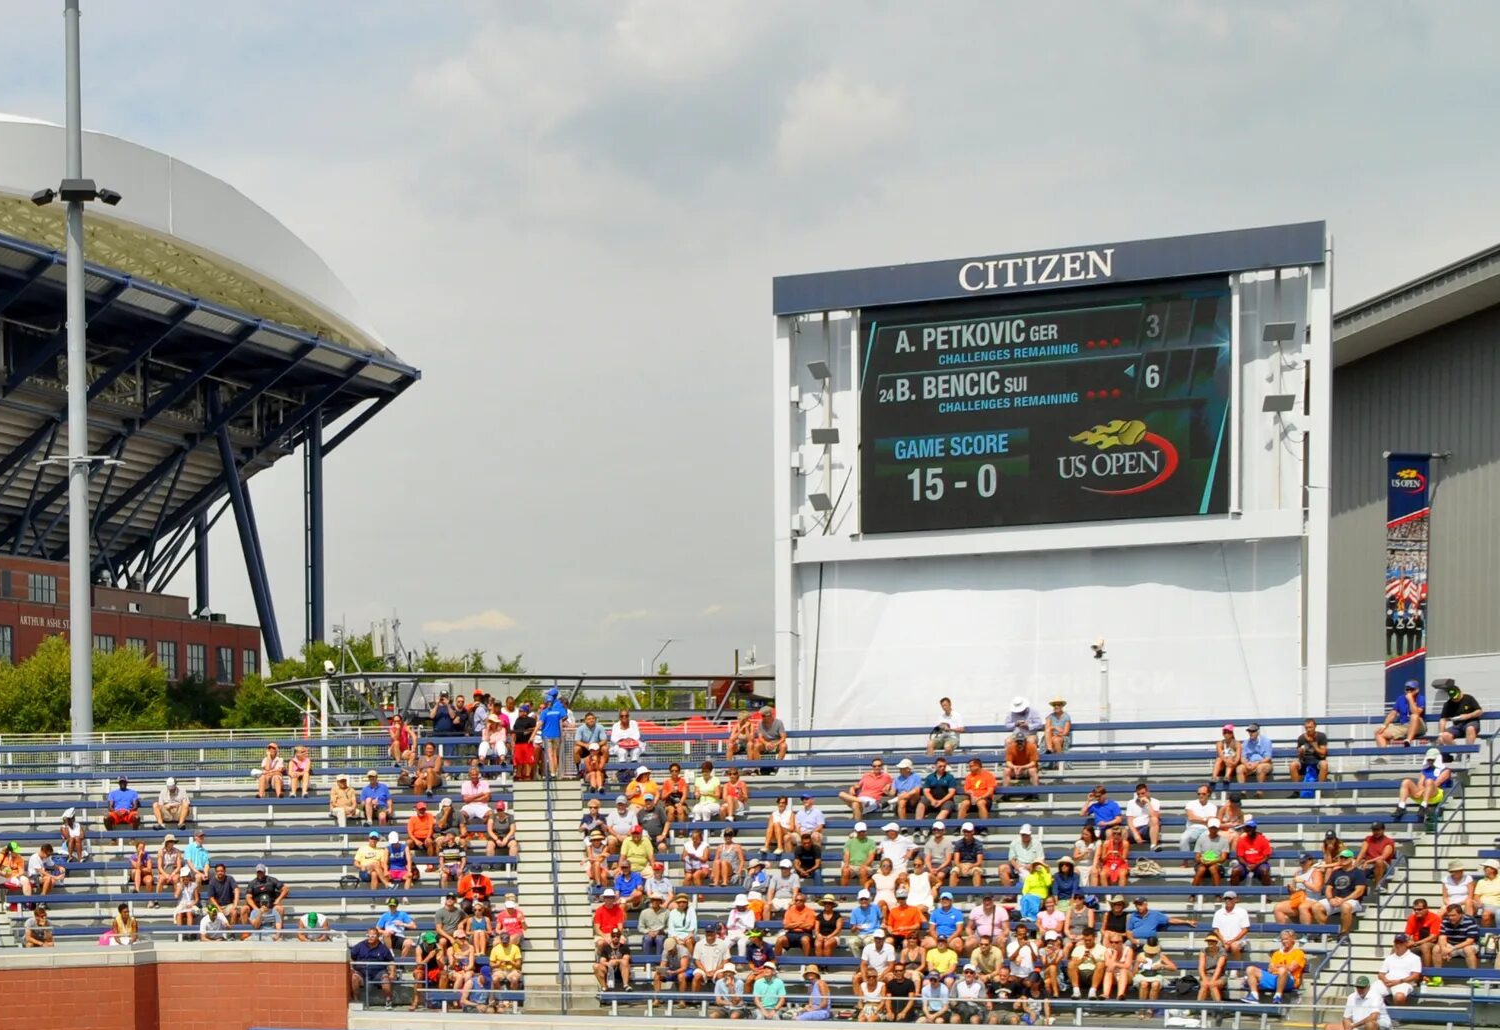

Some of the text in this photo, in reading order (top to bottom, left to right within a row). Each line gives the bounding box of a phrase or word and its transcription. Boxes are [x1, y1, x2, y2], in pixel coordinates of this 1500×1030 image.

[958, 248, 1115, 292] CITIZEN
[895, 319, 1058, 353] A. PETKOVIC GER
[1146, 314, 1160, 338] 3
[938, 343, 1079, 366] CHALLENGES REMAINING
[879, 371, 1028, 403] 24 B. BENCIC SUI
[1145, 364, 1160, 388] 6
[938, 392, 1079, 414] CHALLENGES REMAINING
[894, 433, 1009, 461] GAME SCORE
[1058, 450, 1161, 479] US OPEN
[907, 467, 944, 502] 15
[977, 463, 997, 499] 0
[1391, 479, 1421, 488] US OPEN
[20, 615, 45, 627] ARTHUR
[47, 618, 61, 628] ASHE
